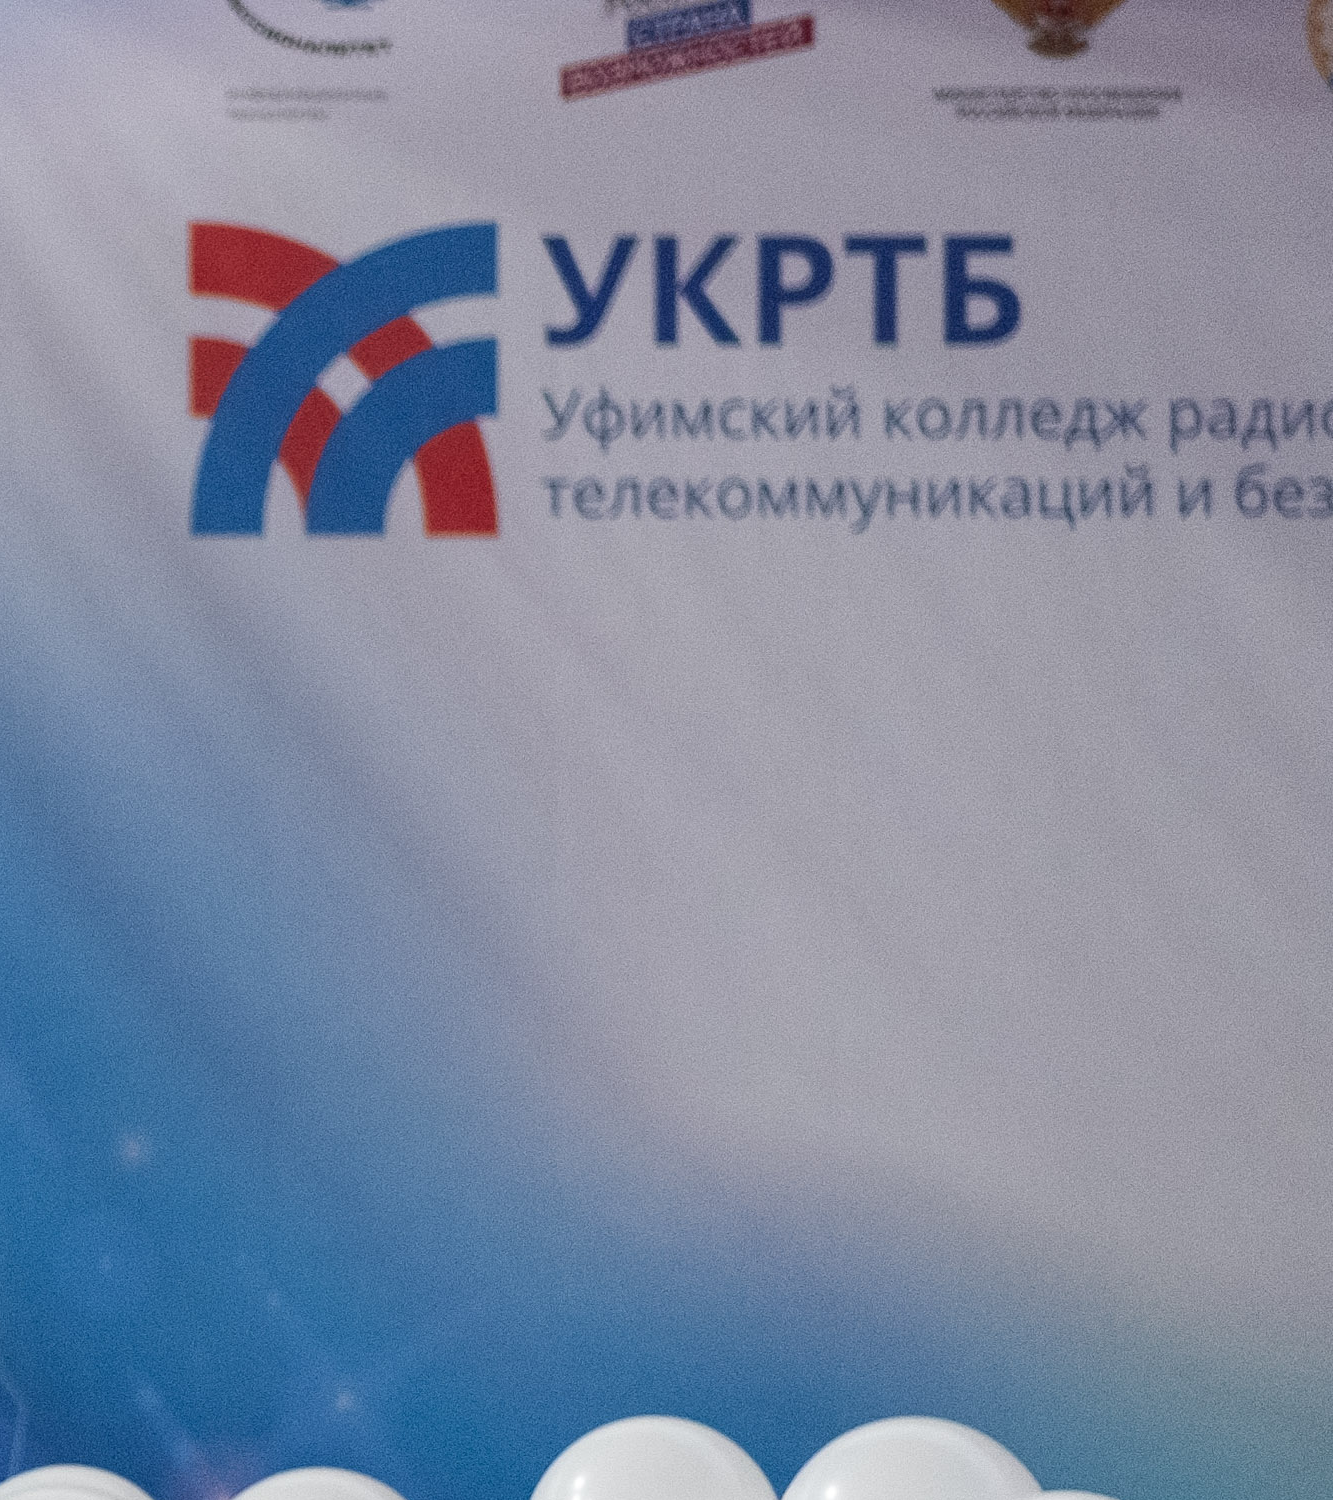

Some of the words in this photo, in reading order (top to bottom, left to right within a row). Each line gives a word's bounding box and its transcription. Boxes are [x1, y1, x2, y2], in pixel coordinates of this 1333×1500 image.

[542, 236, 1022, 346] УКРТБ
[542, 386, 860, 453] Уфимский
[884, 398, 1147, 451] колледж
[542, 464, 1154, 533] телекоммуникаций
[1178, 478, 1212, 520] и
[1235, 463, 1333, 519] без
